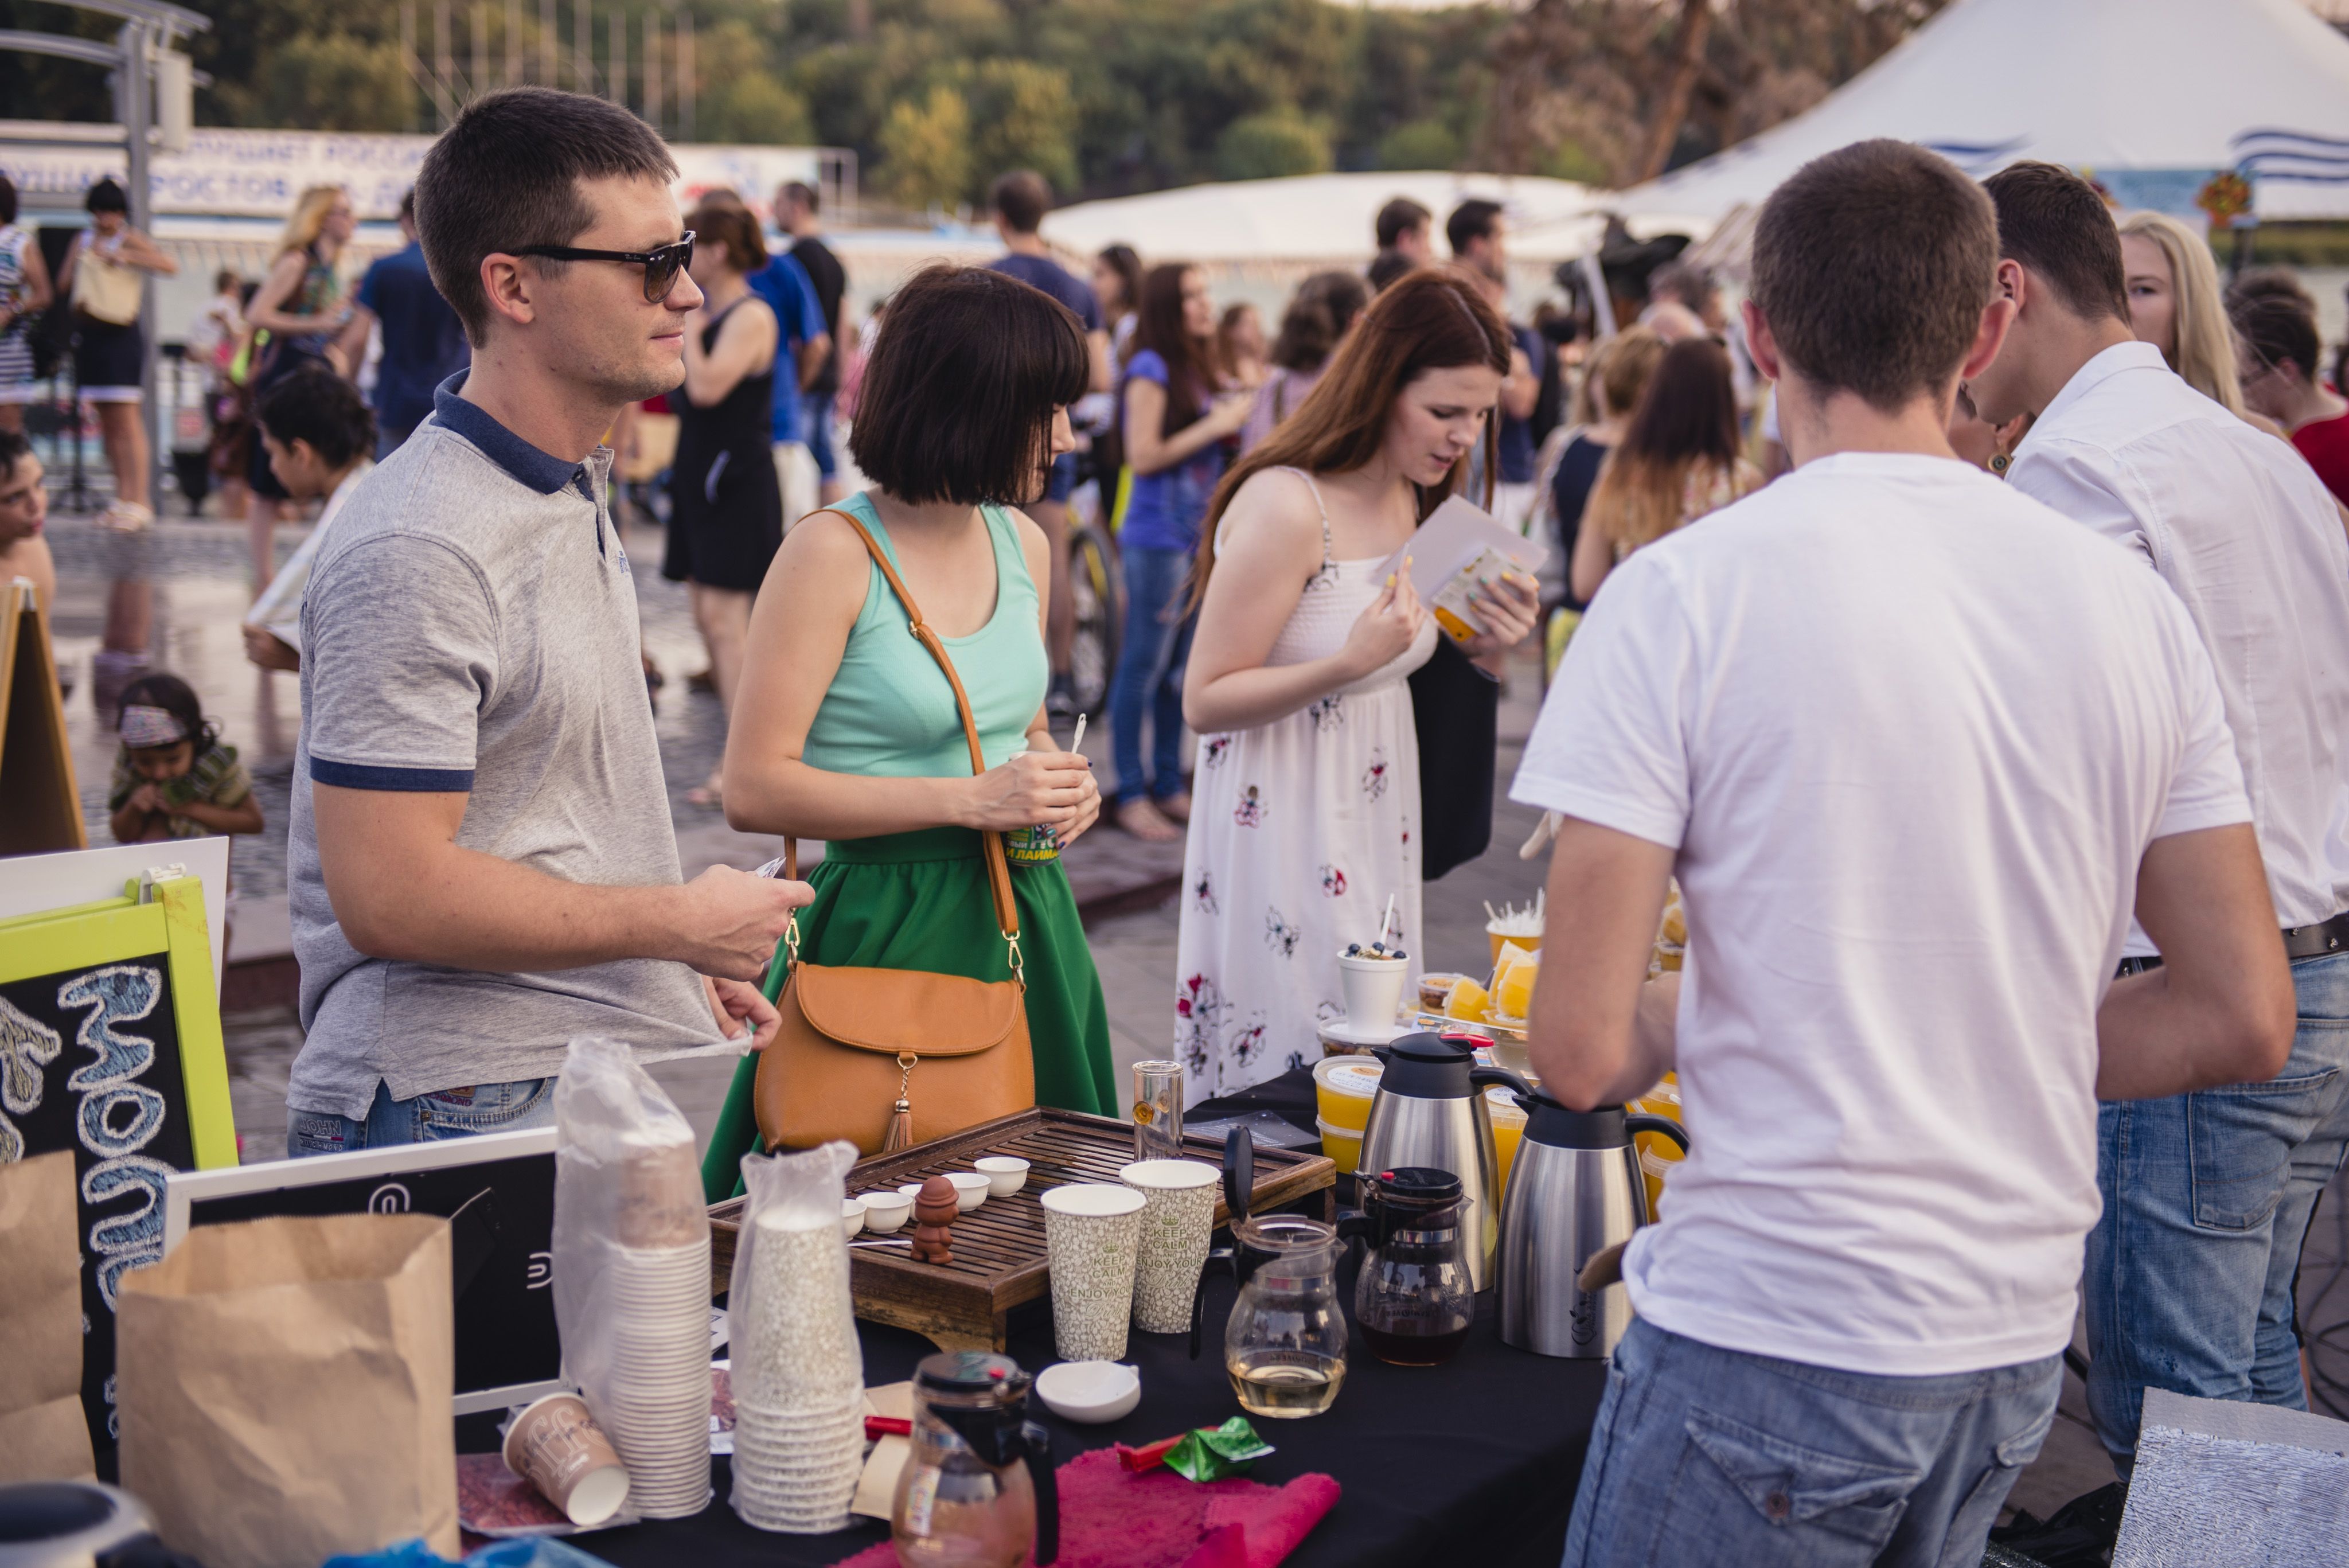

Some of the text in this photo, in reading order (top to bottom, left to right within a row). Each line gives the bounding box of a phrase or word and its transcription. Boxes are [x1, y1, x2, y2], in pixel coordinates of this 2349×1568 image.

[299, 1118, 341, 1136] JOHN
[1153, 1229, 1187, 1238] KEEP
[1153, 1241, 1187, 1249] CALM
[1094, 1255, 1125, 1266] KEEP
[1136, 1257, 1202, 1268] ENJOY YOUR
[1092, 1267, 1125, 1279] CALM
[1070, 1288, 1110, 1298] ENJOY
